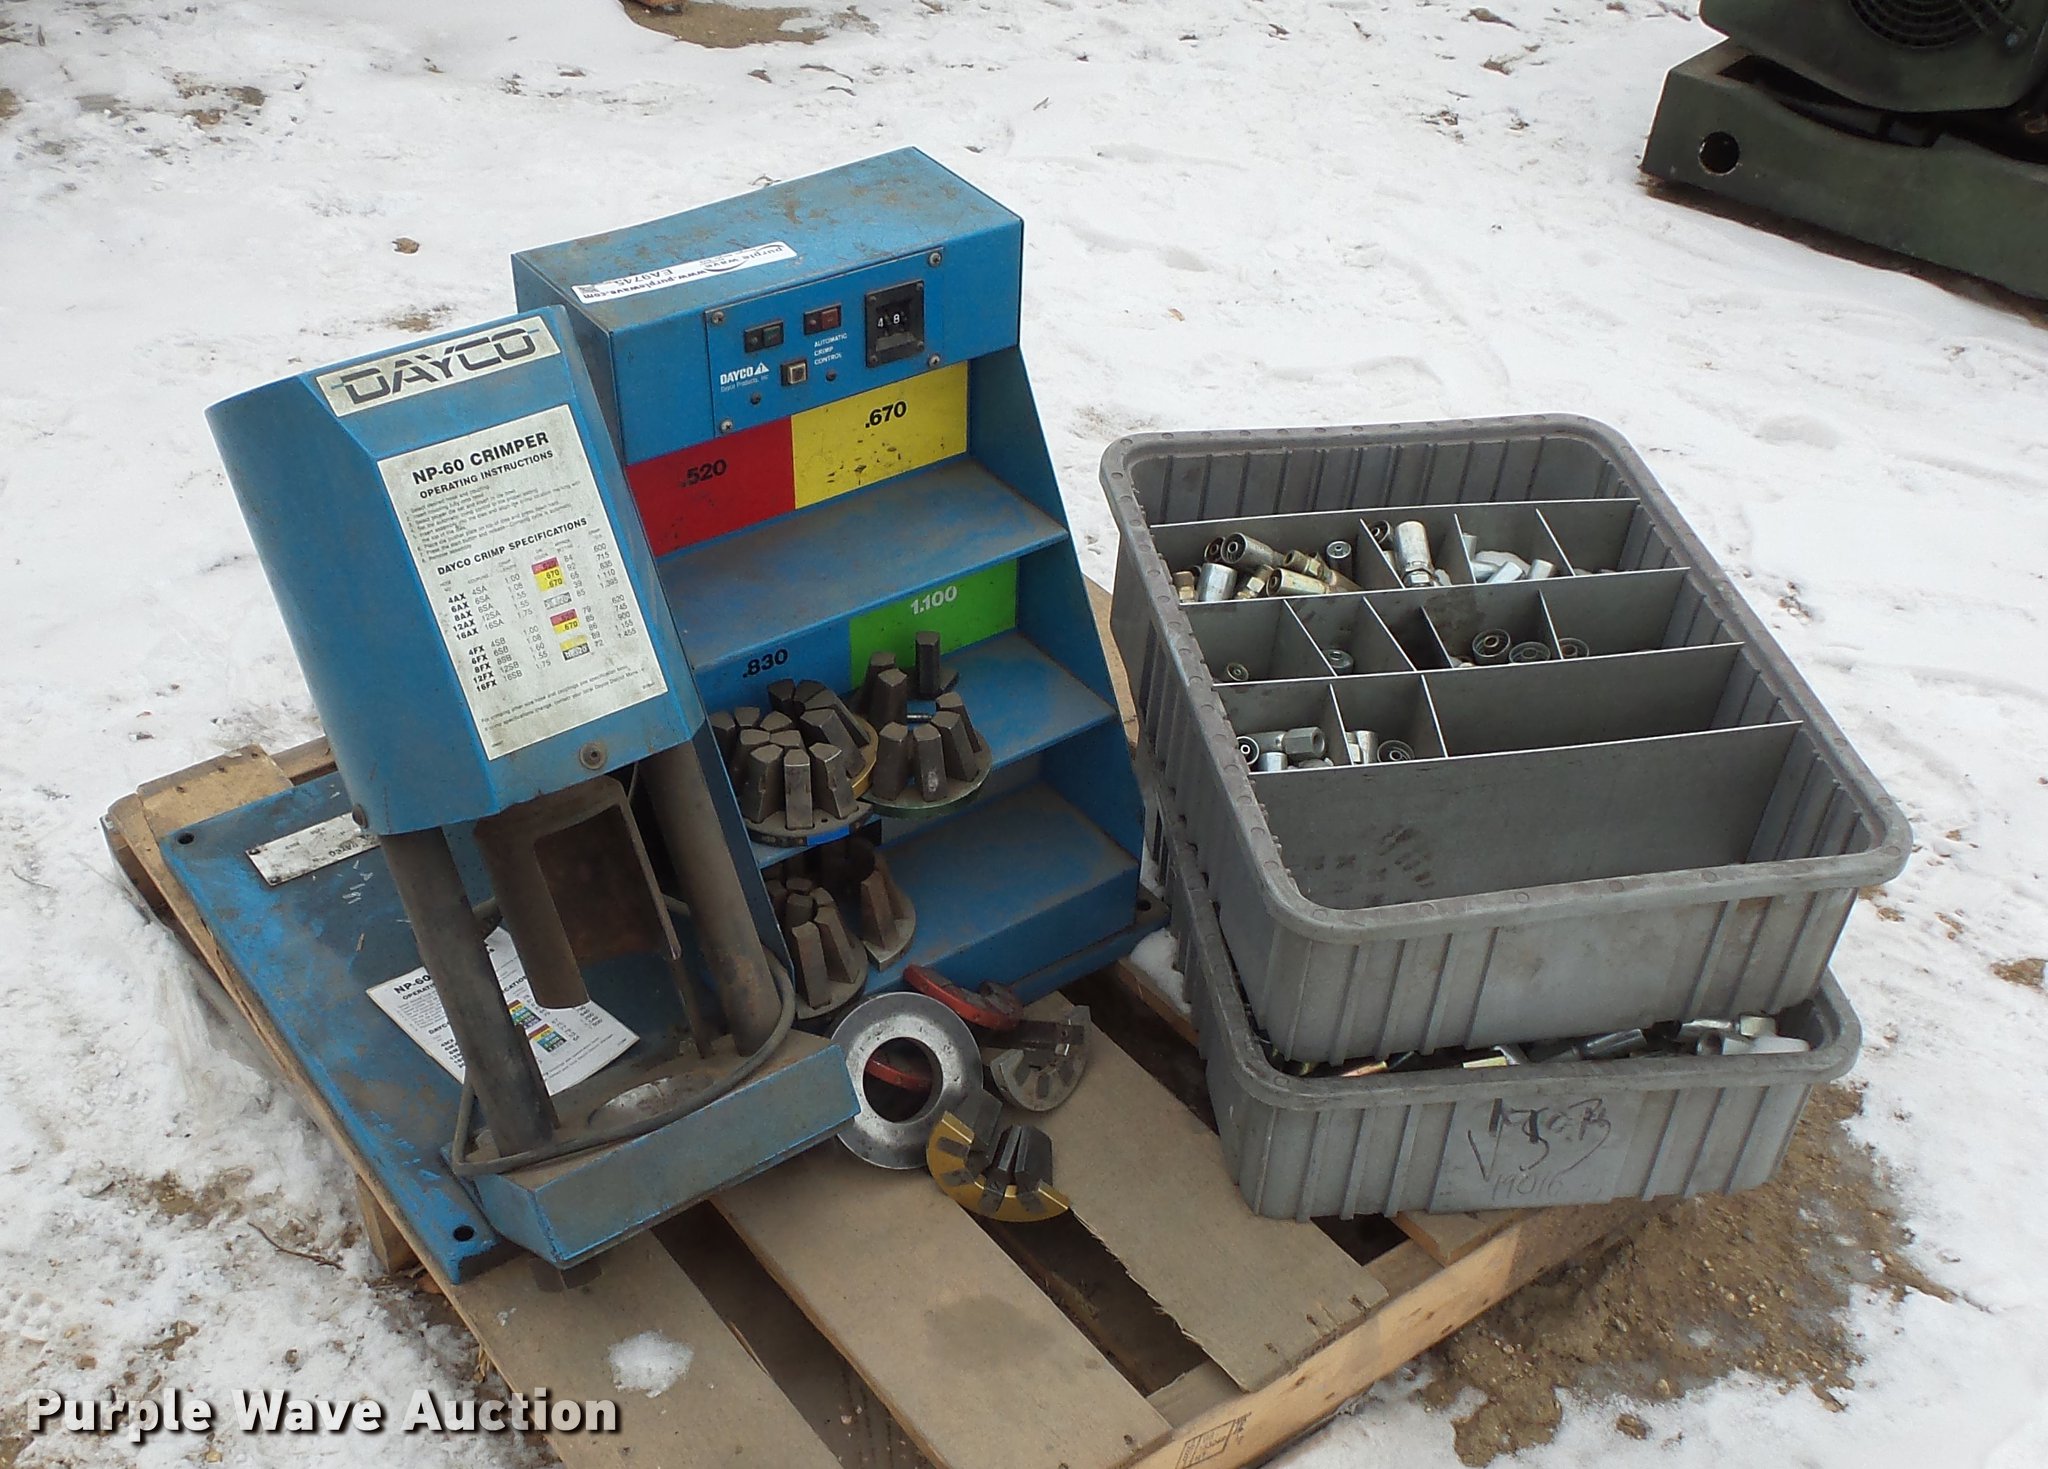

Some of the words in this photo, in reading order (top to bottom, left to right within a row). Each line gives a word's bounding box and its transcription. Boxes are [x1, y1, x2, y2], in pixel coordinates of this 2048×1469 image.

[814, 332, 848, 349] AUTOMATIC
[814, 346, 834, 357] CRIMP
[338, 326, 537, 406] DAYCO
[814, 352, 842, 366] CONTROL
[720, 366, 754, 386] DAYCO
[864, 401, 908, 430] .670
[412, 458, 464, 484] NP-60
[469, 431, 548, 465] CRIMPER
[419, 474, 478, 498] OPERATING
[480, 449, 553, 479] INSTRUCTIONS
[682, 458, 727, 488] .520
[437, 558, 470, 575] DAYCO
[473, 545, 505, 562] CRIMP
[508, 517, 586, 550] SPECIFICATIONS
[448, 592, 466, 603] 4AX
[451, 601, 469, 611] 6AX
[910, 586, 957, 616] 1.100
[454, 618, 476, 630] 12AX
[457, 627, 479, 639] 16AX
[742, 649, 788, 679] .830
